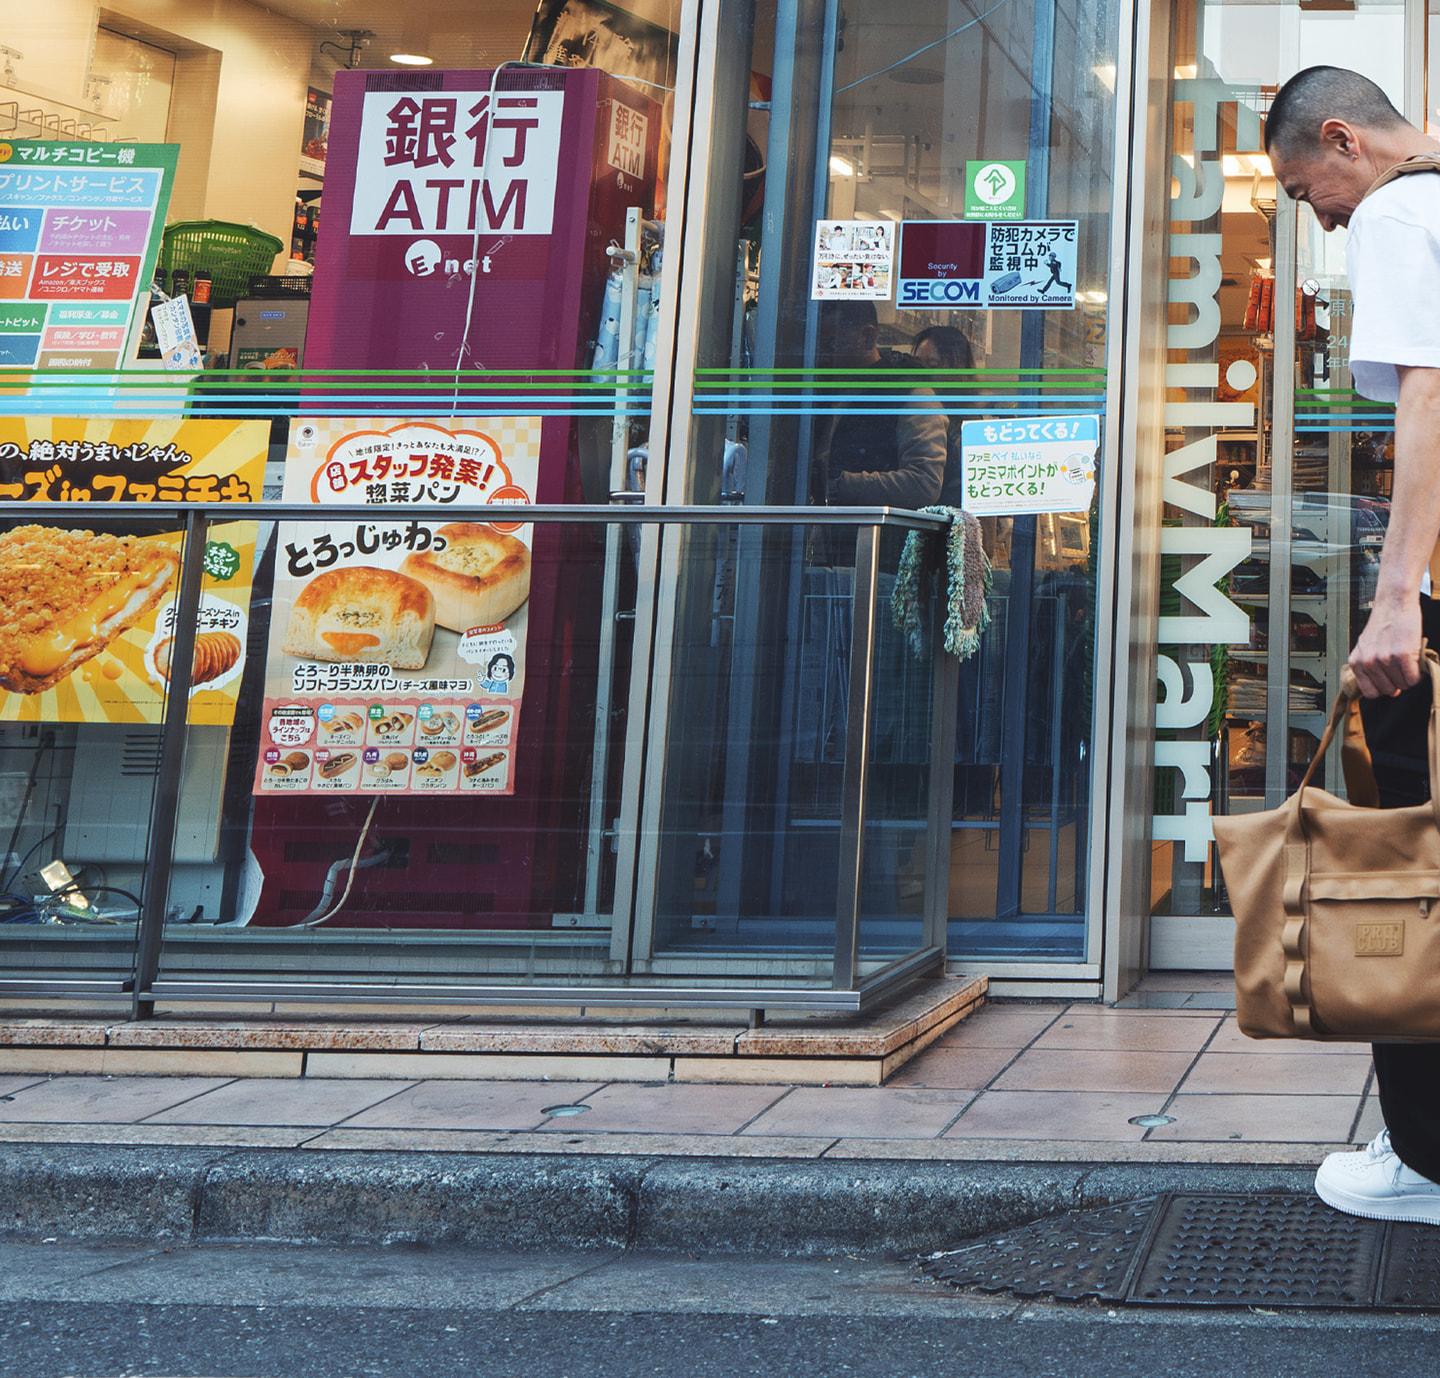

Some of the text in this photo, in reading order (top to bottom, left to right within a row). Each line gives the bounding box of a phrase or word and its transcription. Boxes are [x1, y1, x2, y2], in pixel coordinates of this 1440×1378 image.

[384, 95, 539, 169] 銀行
[615, 105, 643, 147] 銀行
[17, 147, 136, 164] マルチコピー機
[612, 143, 640, 177] ATM
[0, 173, 145, 193] プリントサービス
[374, 179, 528, 230] ATM
[52, 216, 117, 232] チケット
[990, 227, 1075, 242] 防犯カメラで
[990, 242, 1051, 256] セコムが
[0, 261, 23, 277] 送
[43, 262, 130, 278] レジで受取
[928, 262, 957, 271] Security
[989, 257, 1038, 272] 監視中
[937, 270, 947, 278] by
[903, 281, 980, 301] SECOM
[988, 294, 1072, 303] Monitored by Camera
[1327, 335, 1348, 349] 24
[984, 422, 1080, 442] もどってくる!
[0, 441, 192, 463] の、絶対うまいじゃん。
[968, 451, 1042, 463] ファミペイ 払いなら
[349, 453, 495, 491] スタッフ発案!
[968, 461, 1058, 481] ファミマポイントが
[366, 482, 461, 503] 惣菜パン
[968, 482, 1045, 498] もどってくる!
[284, 521, 448, 577] とろっじゅわっ
[272, 726, 311, 734] ラインナップは
[280, 734, 301, 742] こちら
